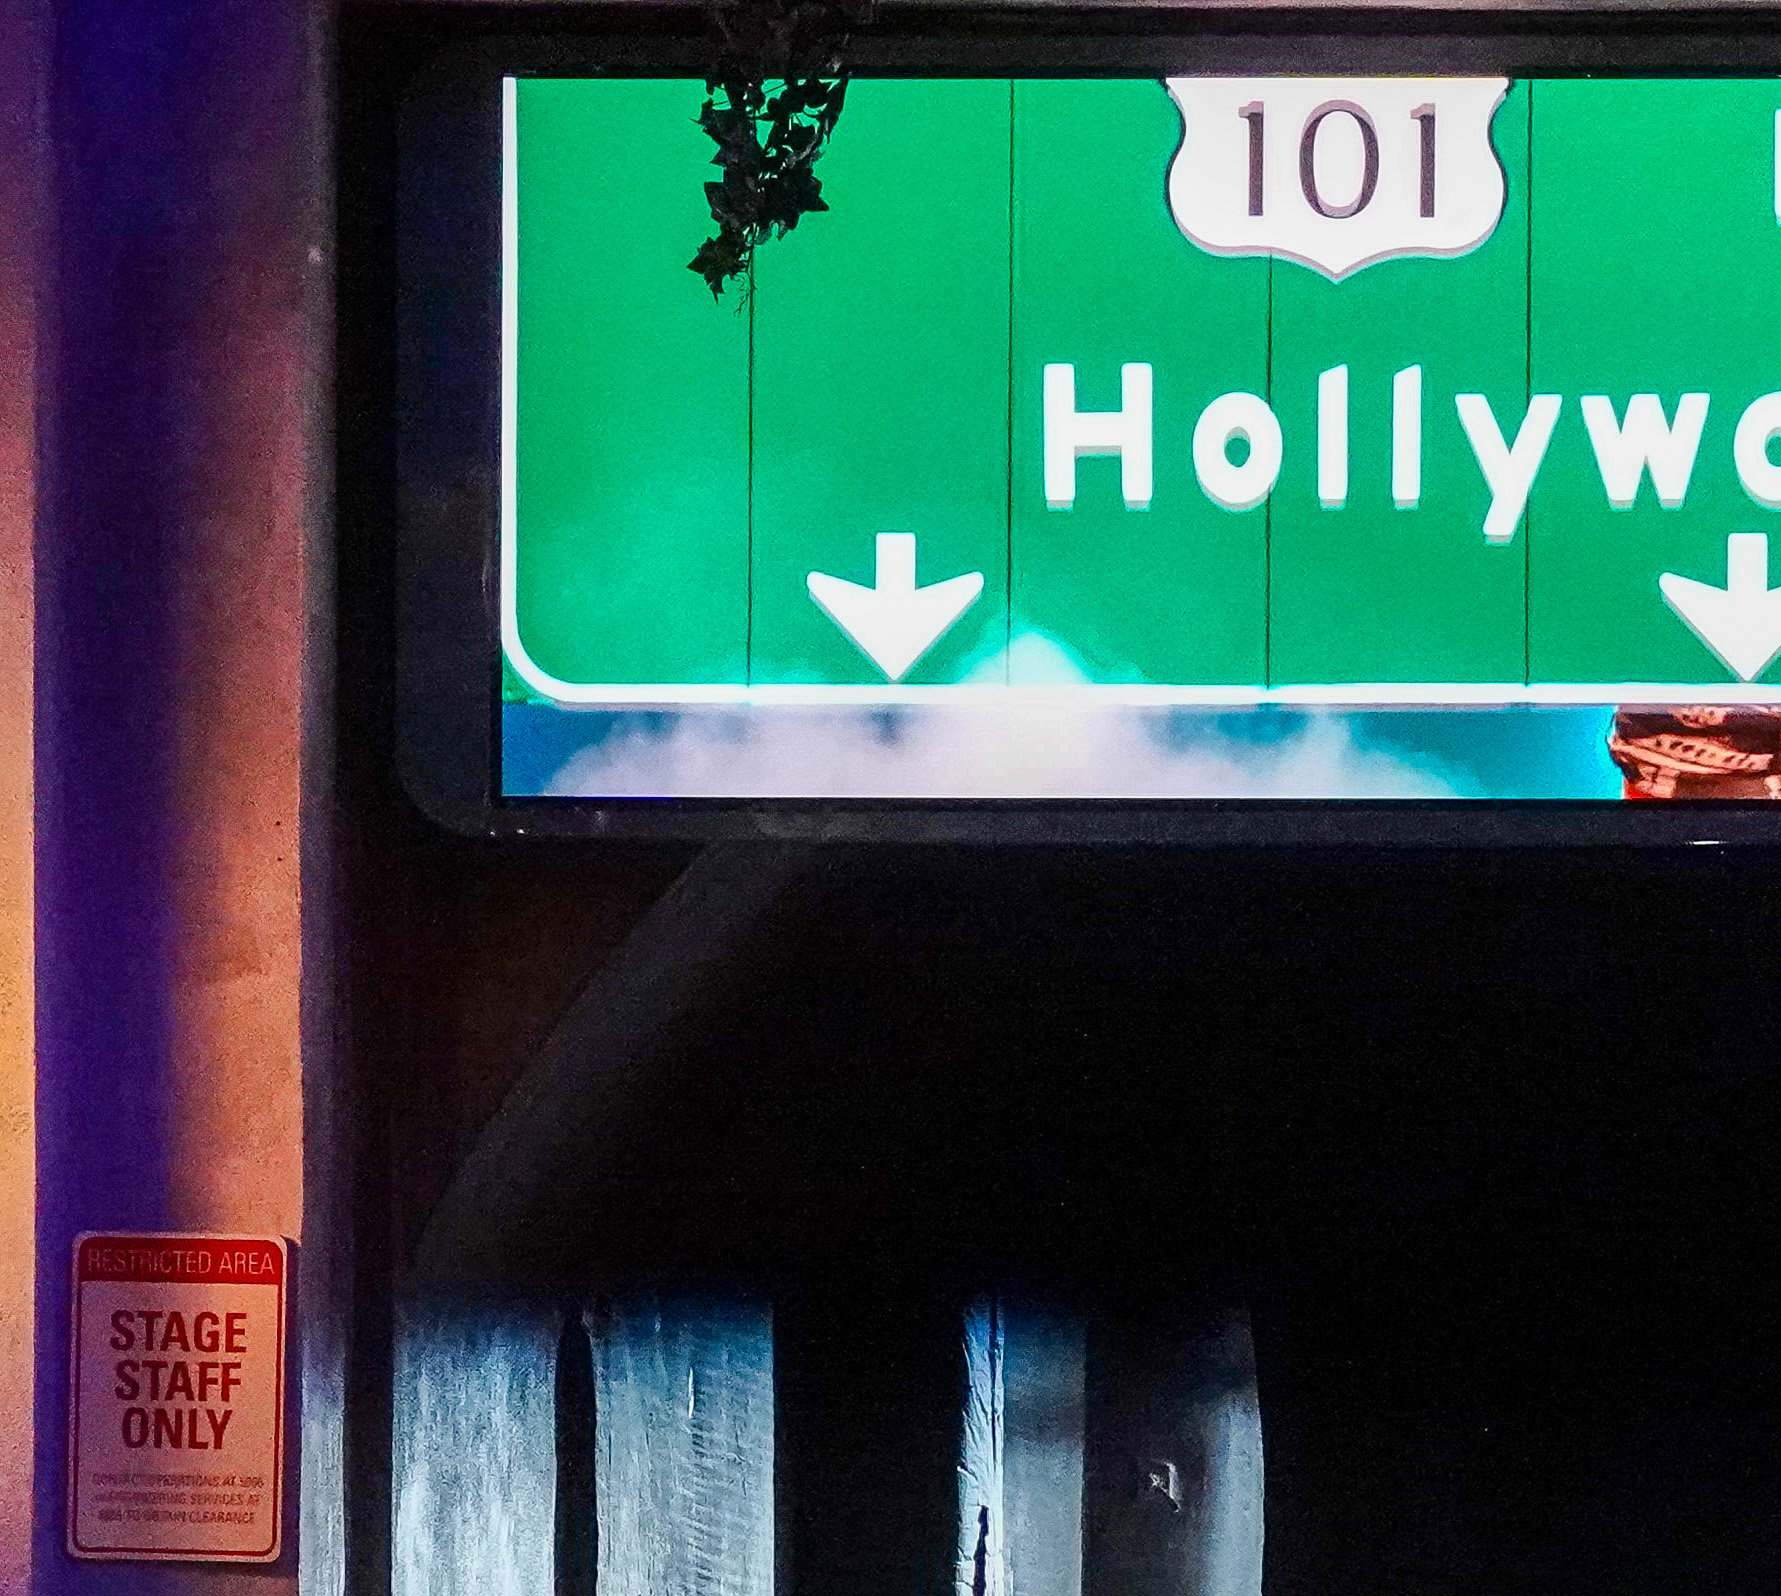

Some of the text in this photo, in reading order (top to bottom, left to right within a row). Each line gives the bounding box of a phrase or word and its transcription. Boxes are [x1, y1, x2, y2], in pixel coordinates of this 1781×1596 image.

[1237, 99, 1436, 218] 101
[87, 1248, 275, 1275] RESTRICTED AREA
[109, 1308, 248, 1353] STAGE
[114, 1359, 242, 1403] STAFF
[120, 1406, 234, 1451] ONLY
